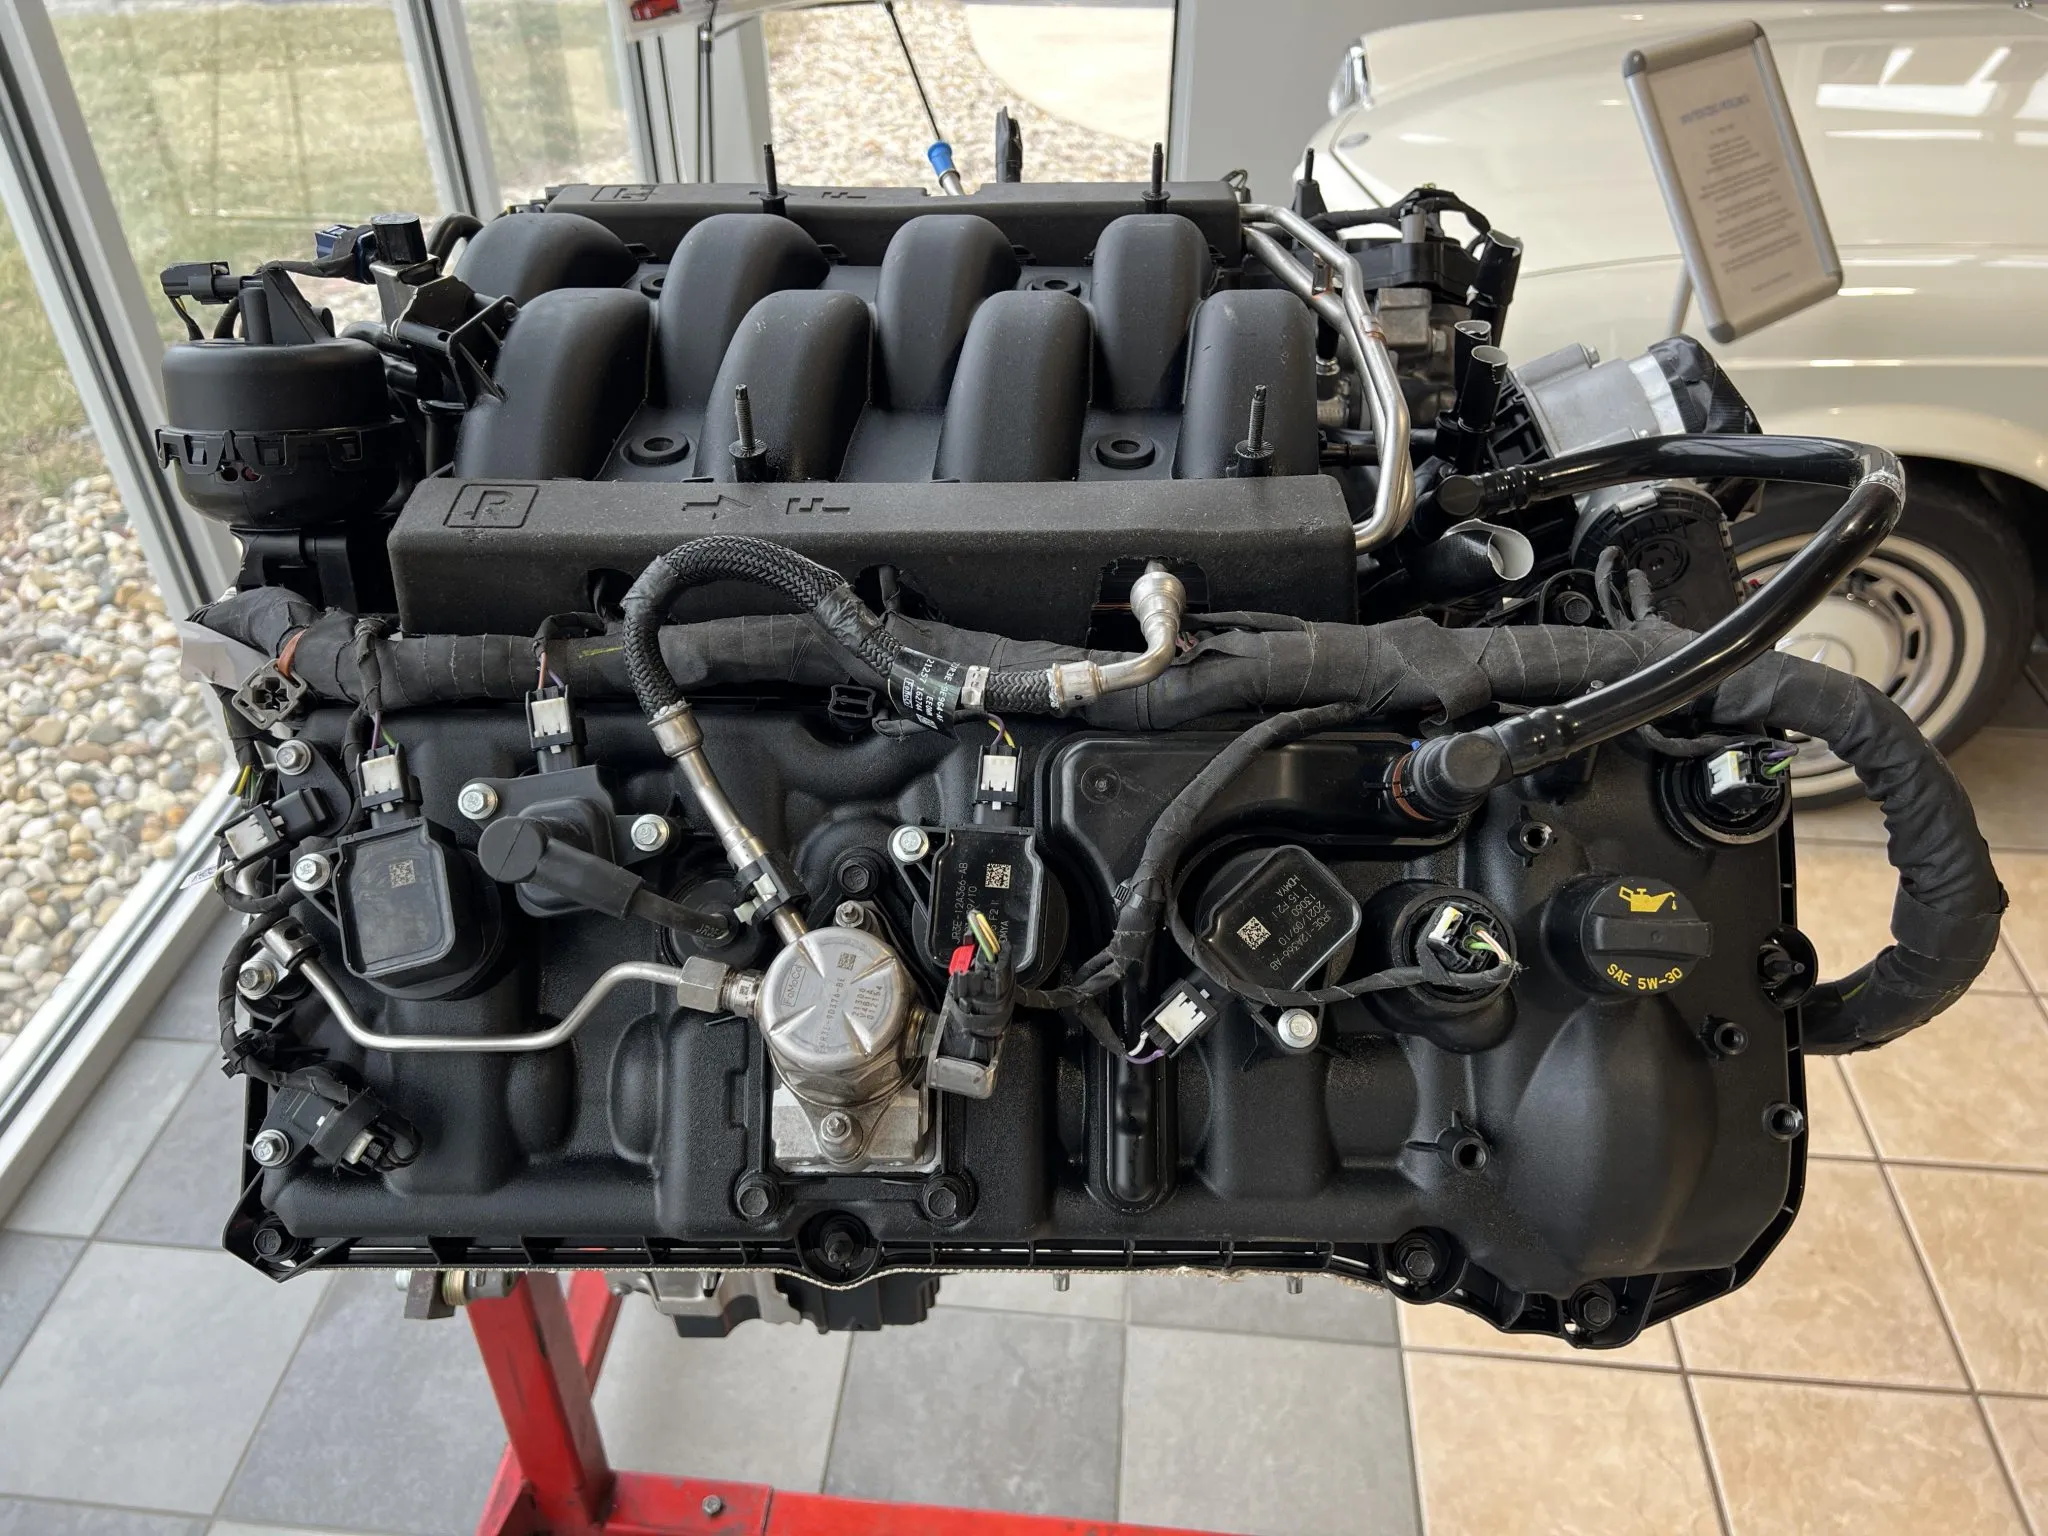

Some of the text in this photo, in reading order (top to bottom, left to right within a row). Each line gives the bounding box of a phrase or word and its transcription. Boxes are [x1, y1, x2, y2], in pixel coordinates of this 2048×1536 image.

[951, 862, 968, 944] JR3E-12A366-AB
[1275, 874, 1301, 897] HDMYA
[1291, 893, 1316, 917] 13060
[1269, 909, 1332, 971] JR3E-12A366-AB
[1278, 900, 1325, 946] 2021/09/10
[784, 965, 804, 1007] FoMoCo
[1606, 963, 1683, 990] SAE 5W-30
